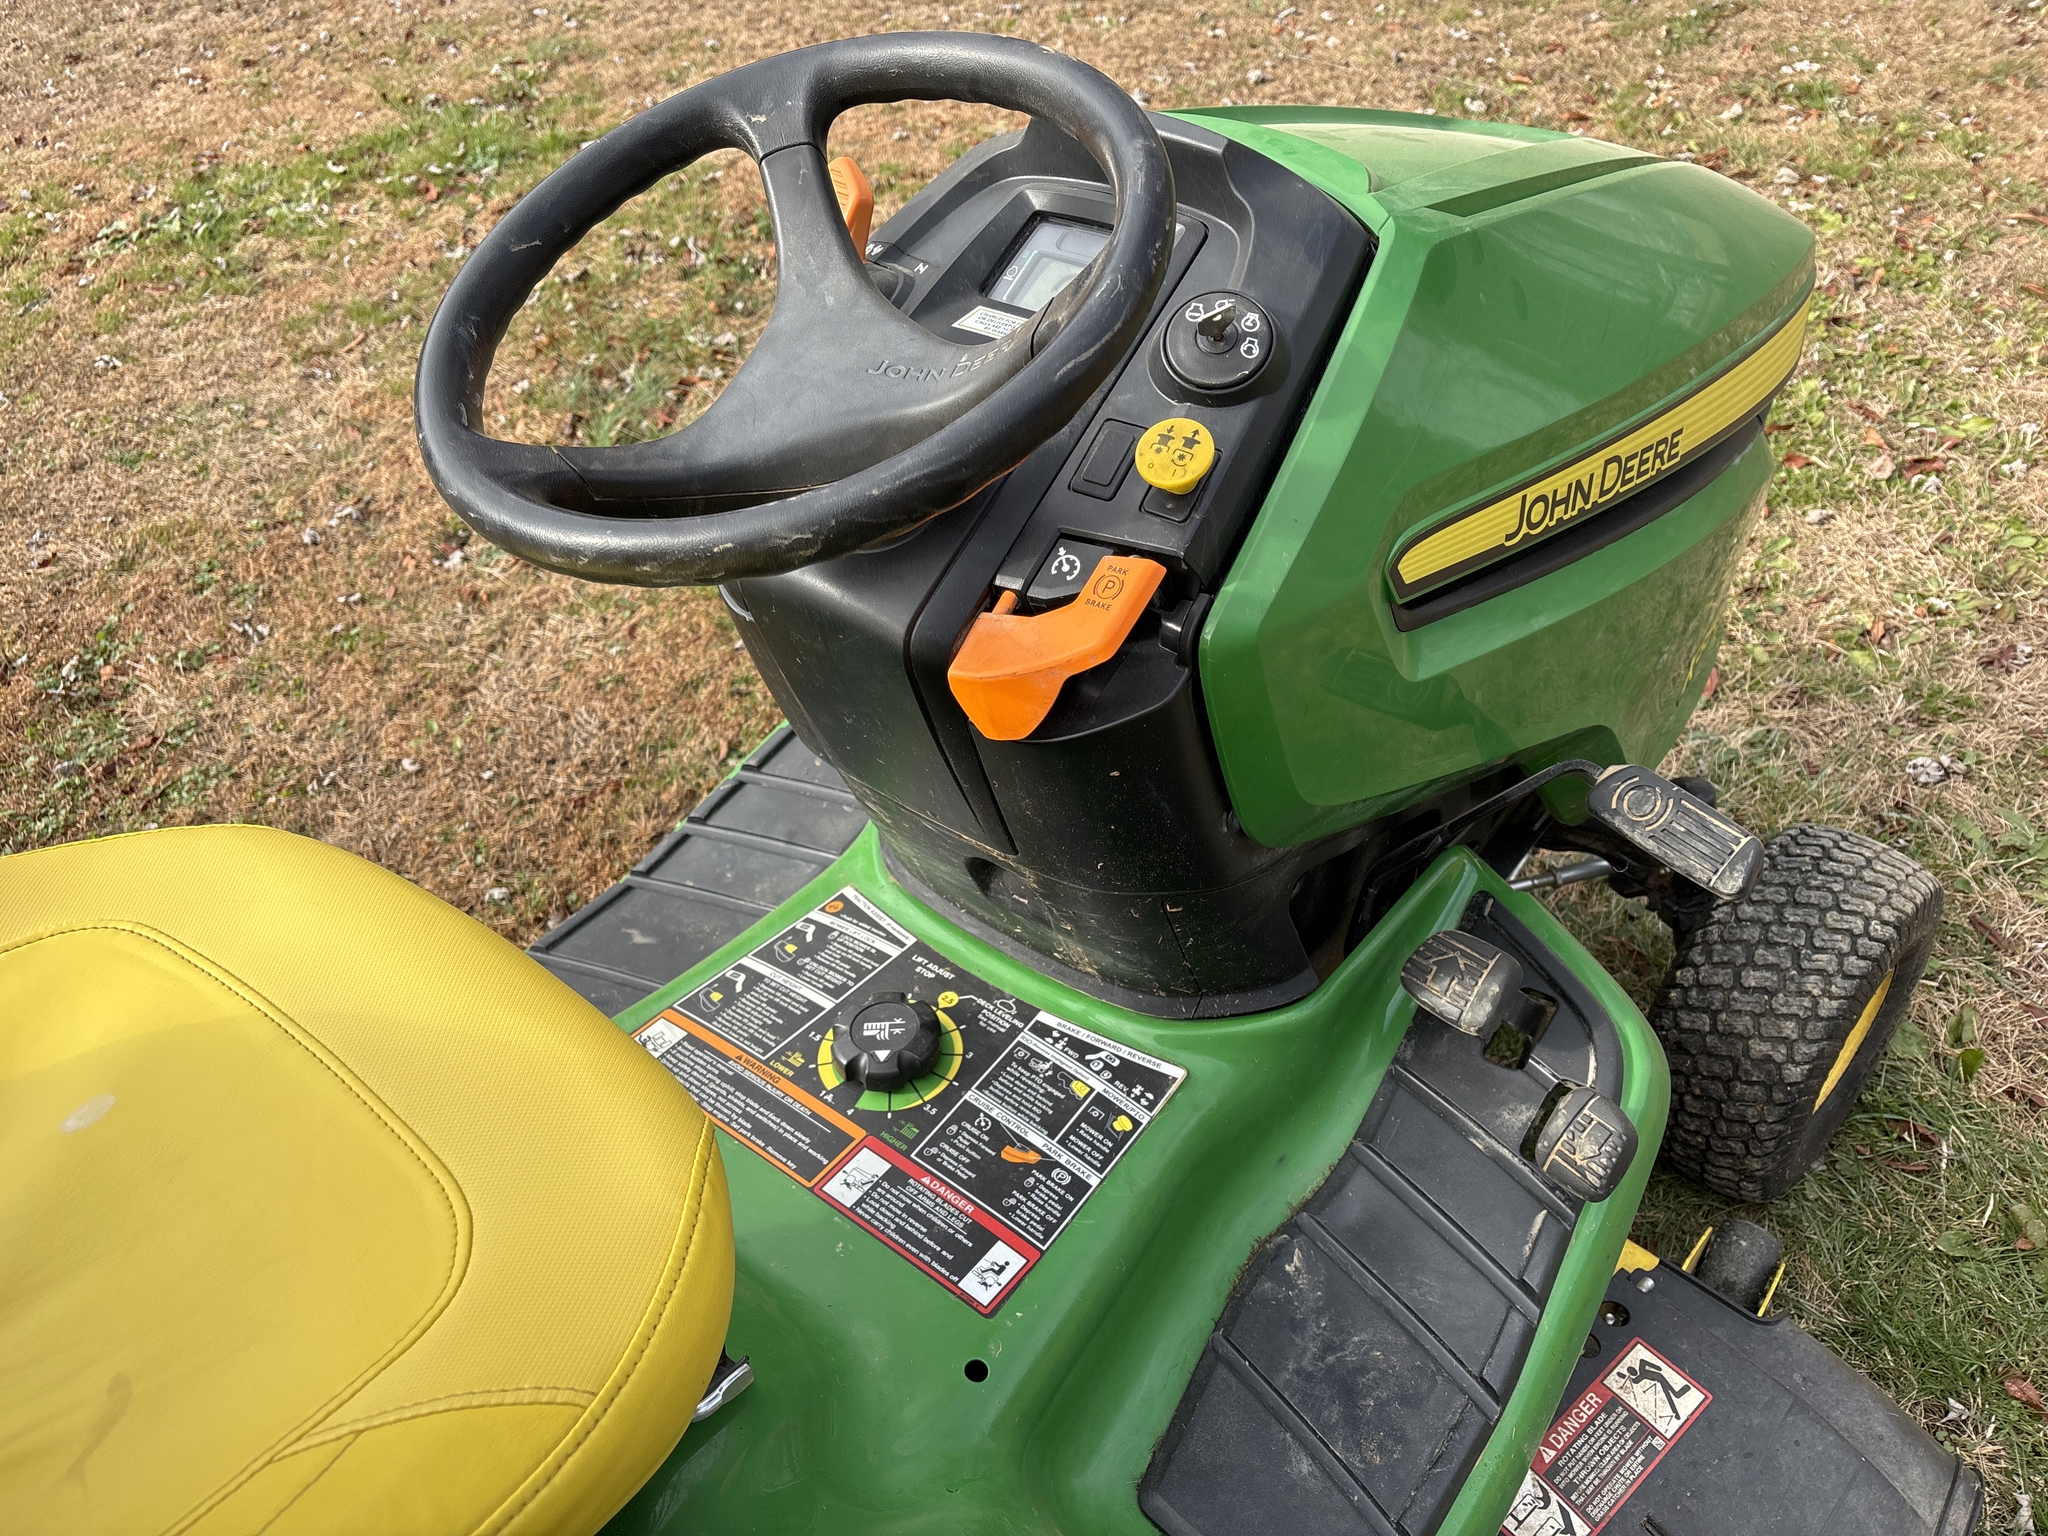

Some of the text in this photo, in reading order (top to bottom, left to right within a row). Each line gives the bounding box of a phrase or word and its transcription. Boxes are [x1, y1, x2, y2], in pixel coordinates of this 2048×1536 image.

[866, 360, 946, 381] JOHN
[1504, 427, 1686, 547] JOHN DEERE
[1107, 565, 1129, 576] PARK
[1085, 598, 1112, 611] BRAKE
[912, 954, 955, 979] LIFT ADJUST
[915, 966, 935, 978] STOP
[941, 995, 954, 1004] 2.5
[976, 998, 1024, 1028] DECK LEVELING
[977, 1013, 1006, 1032] See manual
[981, 1009, 1010, 1028] POSITION
[808, 1031, 822, 1041] 1.5
[1020, 1035, 1032, 1044] RIO
[1056, 1022, 1081, 1035] BRAKE
[1086, 1034, 1122, 1052] FORWARD
[1127, 1051, 1161, 1068] REVERSE
[1063, 1047, 1079, 1058] FWD
[743, 1057, 780, 1083] WARNING
[769, 1060, 794, 1077] LOWER
[1006, 1066, 1045, 1093] while reversing:
[728, 1060, 811, 1116] AVOID SERIOUS INJURY OR DEATH
[1017, 1066, 1030, 1076] keep
[1030, 1074, 1043, 1084] PTO
[1042, 1083, 1065, 1098] engaged
[1114, 1080, 1129, 1093] REV
[923, 1104, 937, 1115] 3.5
[968, 1094, 1028, 1137] CRUISE CONTROL
[1102, 1088, 1144, 1120] MOWER/PTO
[880, 1131, 907, 1150] HIGHER
[957, 1135, 970, 1145] Pedal
[961, 1121, 990, 1141] CRUISE ON
[961, 1131, 996, 1155] Depress Forward
[1079, 1129, 1109, 1153] Raise handle
[1080, 1122, 1113, 1147] MOWER ON
[939, 1142, 970, 1163] CRUISE OFF
[953, 1139, 981, 1159] Push button
[1067, 1142, 1101, 1167] Lower handle
[1069, 1134, 1104, 1159] MOWER OFF
[940, 1152, 976, 1178] Depress Forward
[942, 1160, 955, 1171] Brake
[954, 1169, 968, 1179] Pedal
[1042, 1143, 1092, 1180] PARK BRAKE
[876, 1187, 905, 1207] are around
[930, 1181, 974, 1213] DANGER
[1031, 1169, 1074, 1201] PARK BRAKE ON
[1037, 1184, 1058, 1200] Depress
[871, 1191, 880, 1199] Do
[879, 1197, 889, 1206] not
[888, 1204, 902, 1214] mow
[907, 1217, 927, 1232] reverse
[905, 1185, 964, 1230] OFF ARMS AND LEGS
[908, 1178, 972, 1224] ROTATING BLADES CUT
[1012, 1190, 1057, 1223] PARK BRAKE OFF
[1030, 1193, 1061, 1217] Raise handle
[1034, 1188, 1063, 1210] brake pedal
[861, 1203, 896, 1229] while backing
[881, 1181, 890, 1189] Do
[889, 1187, 900, 1195] not
[898, 1193, 912, 1204] mow
[911, 1202, 927, 1214] when
[926, 1213, 948, 1230] children
[954, 1233, 972, 1247] others
[1015, 1209, 1045, 1231] brake pedal
[1018, 1204, 1040, 1220] Depress
[866, 1196, 954, 1260] Look down and behind before and
[1011, 1213, 1044, 1239] Lower handle
[855, 1207, 959, 1282] Never carry children even with blades off
[1549, 1393, 1601, 1448] DANGER
[1558, 1412, 1607, 1466] ROTATING BLADE
[1573, 1425, 1626, 1484] THROWN OBJECTS
[1585, 1435, 1652, 1513] DO NOT OPERATE MOWER WITHOUT
